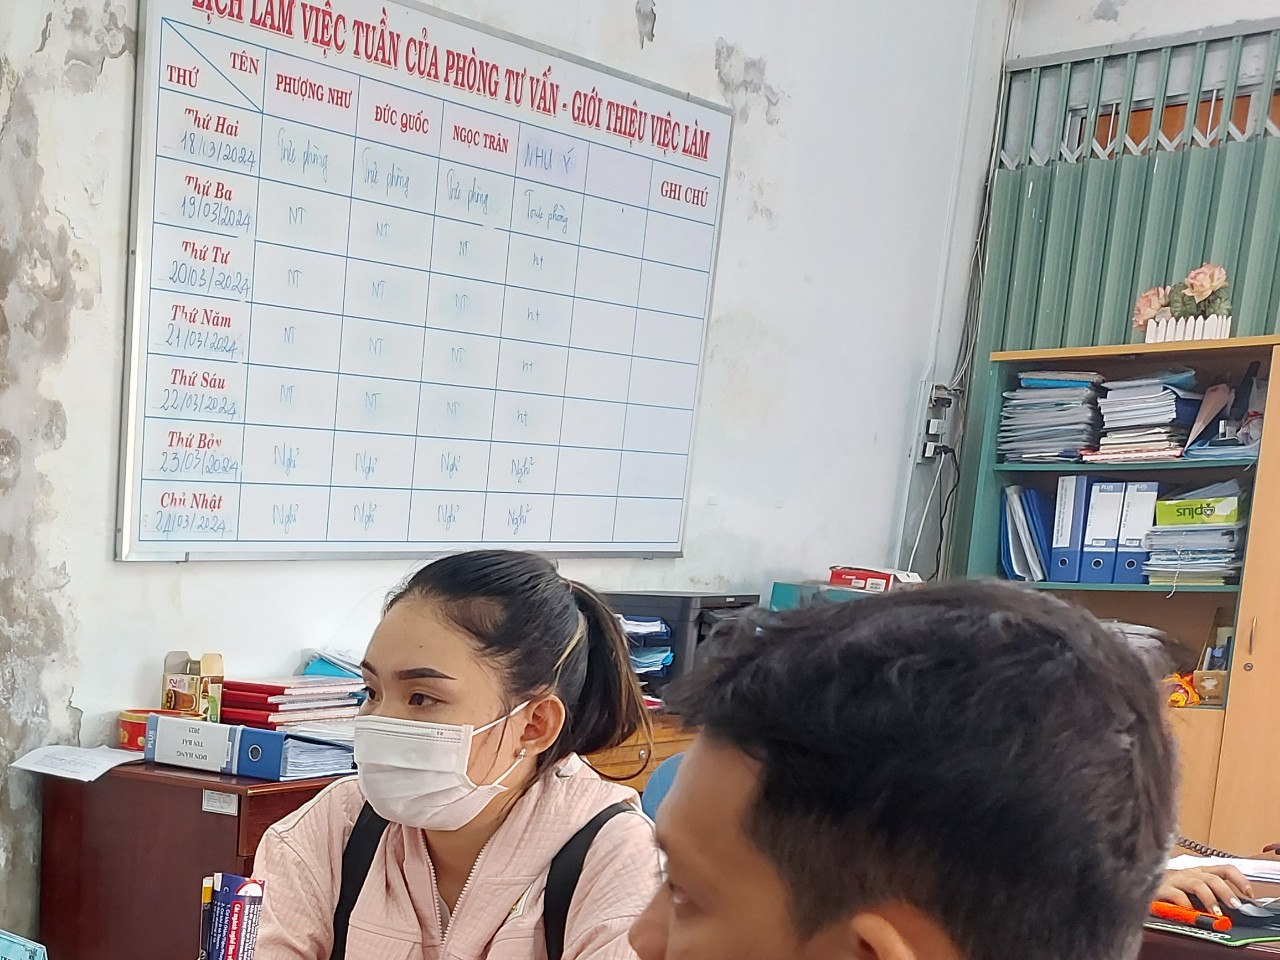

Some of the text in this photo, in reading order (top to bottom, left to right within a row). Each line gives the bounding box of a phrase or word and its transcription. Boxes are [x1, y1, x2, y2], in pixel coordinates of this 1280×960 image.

[230, 51, 260, 75] TÊN
[167, 65, 200, 88] THỨ
[301, 0, 347, 58] VIỆC
[352, 7, 401, 68] TUẦN
[405, 27, 440, 80] CỦA
[444, 47, 500, 98] PHÒNG
[504, 67, 527, 104] TƯ
[530, 65, 560, 115] VẤN
[571, 86, 601, 128] GIỚI
[606, 100, 648, 146] THIỆU
[650, 110, 681, 156] VIỆC
[682, 119, 711, 160] LÀM
[275, 74, 353, 109] PHƯỢNG NHƯ
[215, 116, 241, 137] Hai
[374, 103, 430, 134] ĐỨC QUỐC
[452, 125, 509, 154] NGỌC TRÂN
[214, 182, 234, 201] Ba
[660, 180, 709, 208] GHI CHÚ
[212, 246, 231, 264] Tư
[201, 309, 232, 328] Năm
[201, 372, 226, 390] Sáu
[160, 491, 224, 512] Chủ Nhật
